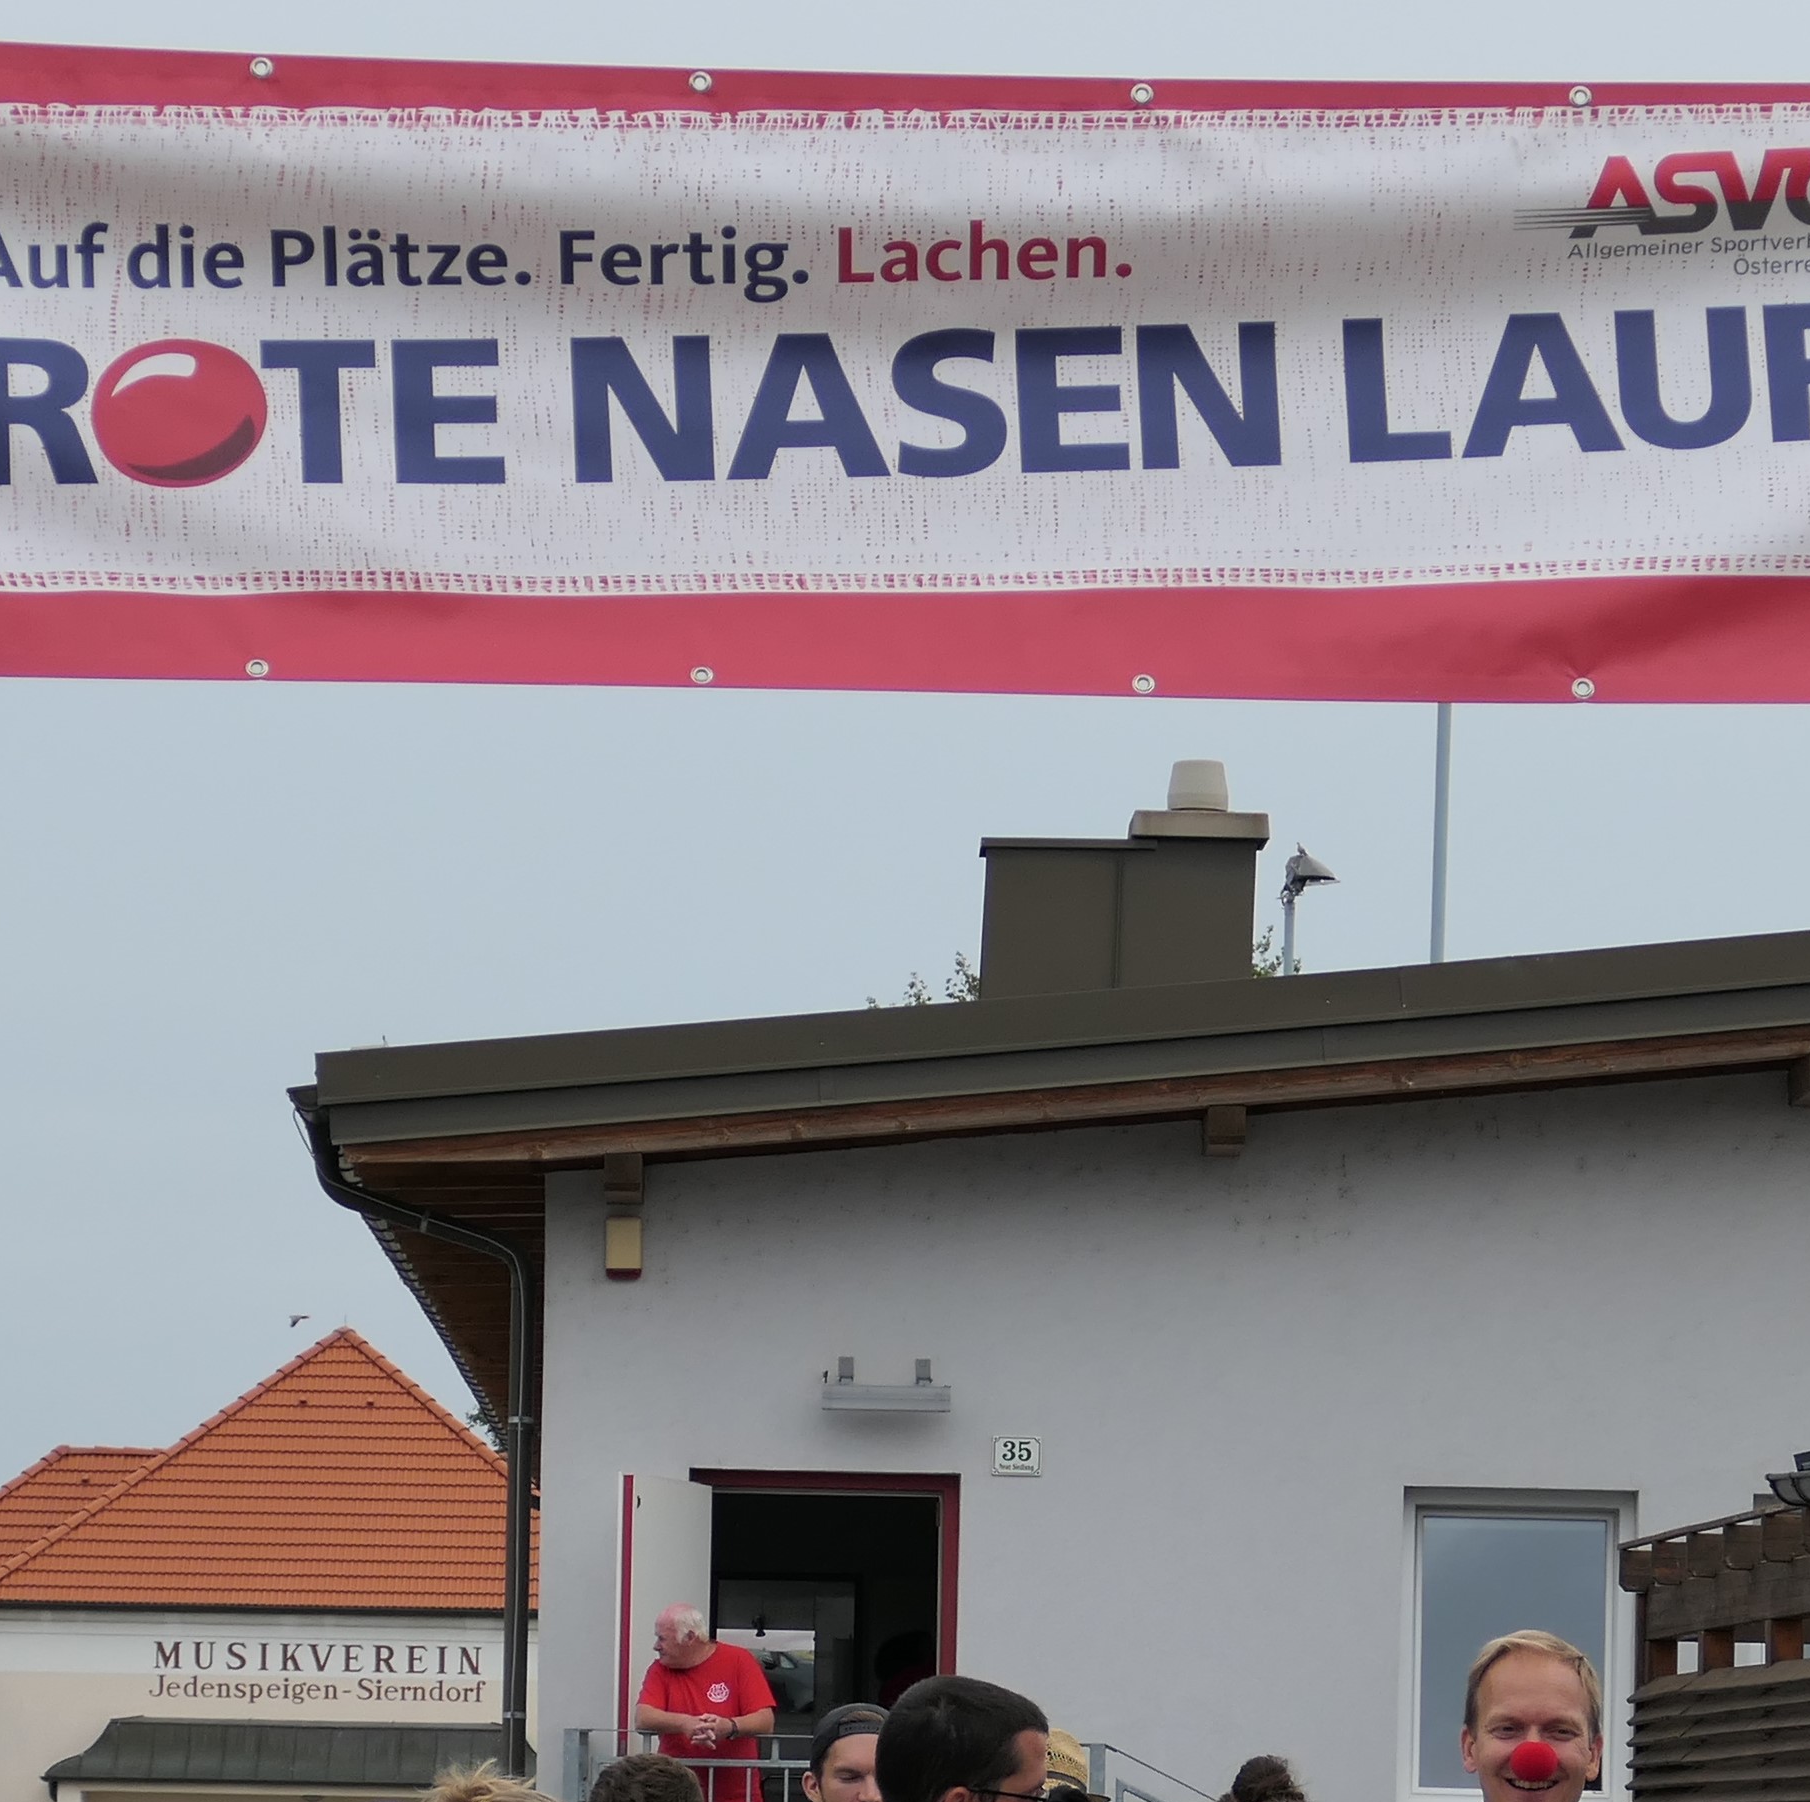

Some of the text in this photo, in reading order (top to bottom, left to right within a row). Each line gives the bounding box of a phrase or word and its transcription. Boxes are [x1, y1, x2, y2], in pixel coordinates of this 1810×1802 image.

[127, 224, 245, 289] die
[271, 226, 531, 288] Plätze.
[559, 226, 809, 303] Fertig.
[837, 220, 1133, 283] Lachen.
[1568, 237, 1704, 260] Allgemeiner
[570, 321, 1282, 483] NASEN
[1002, 1440, 1032, 1461] 35
[153, 1641, 482, 1676] MUSIKVEREIN
